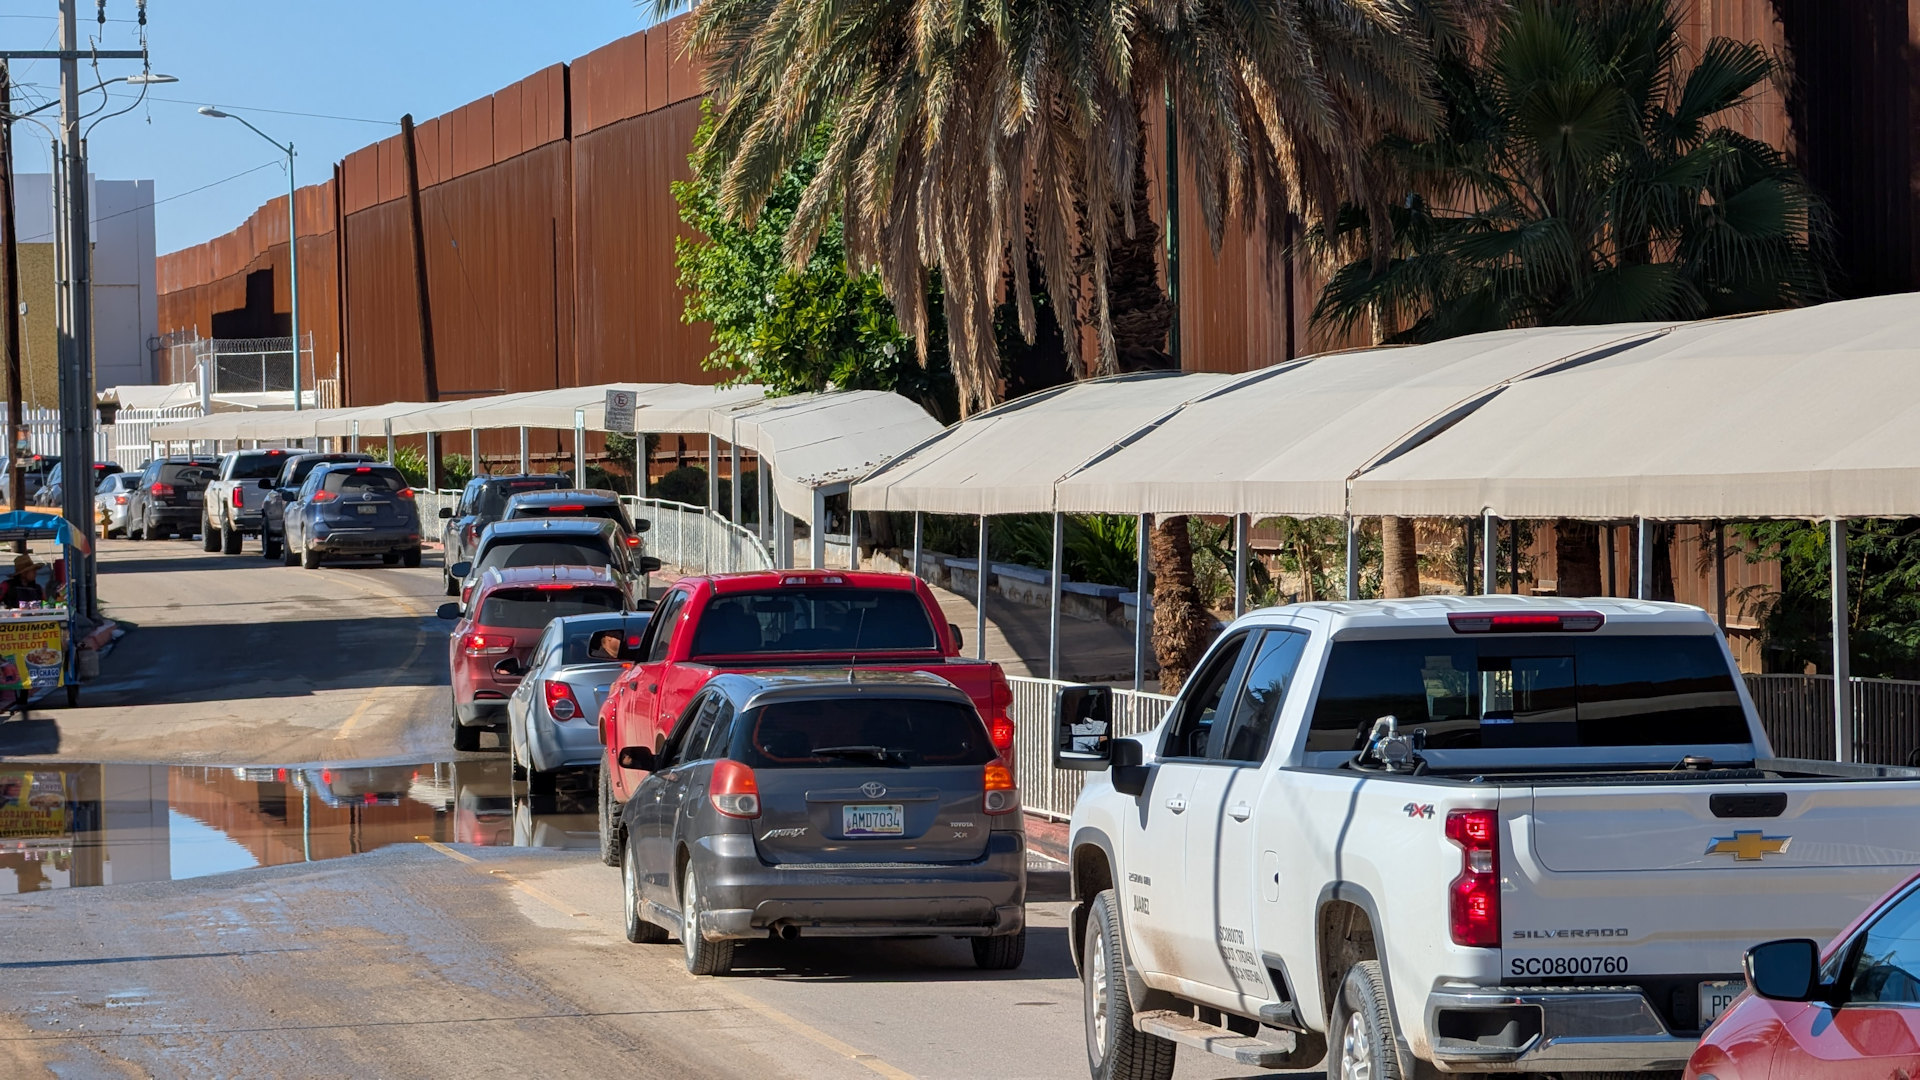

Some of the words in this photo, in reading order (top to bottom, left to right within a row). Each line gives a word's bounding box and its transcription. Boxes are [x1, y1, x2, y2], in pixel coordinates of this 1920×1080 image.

[19, 632, 30, 641] DE
[32, 631, 59, 640] ELOTE
[852, 812, 900, 828] AMD7034
[1512, 928, 1629, 939] SILVERADO
[1511, 956, 1629, 975] SC0800760
